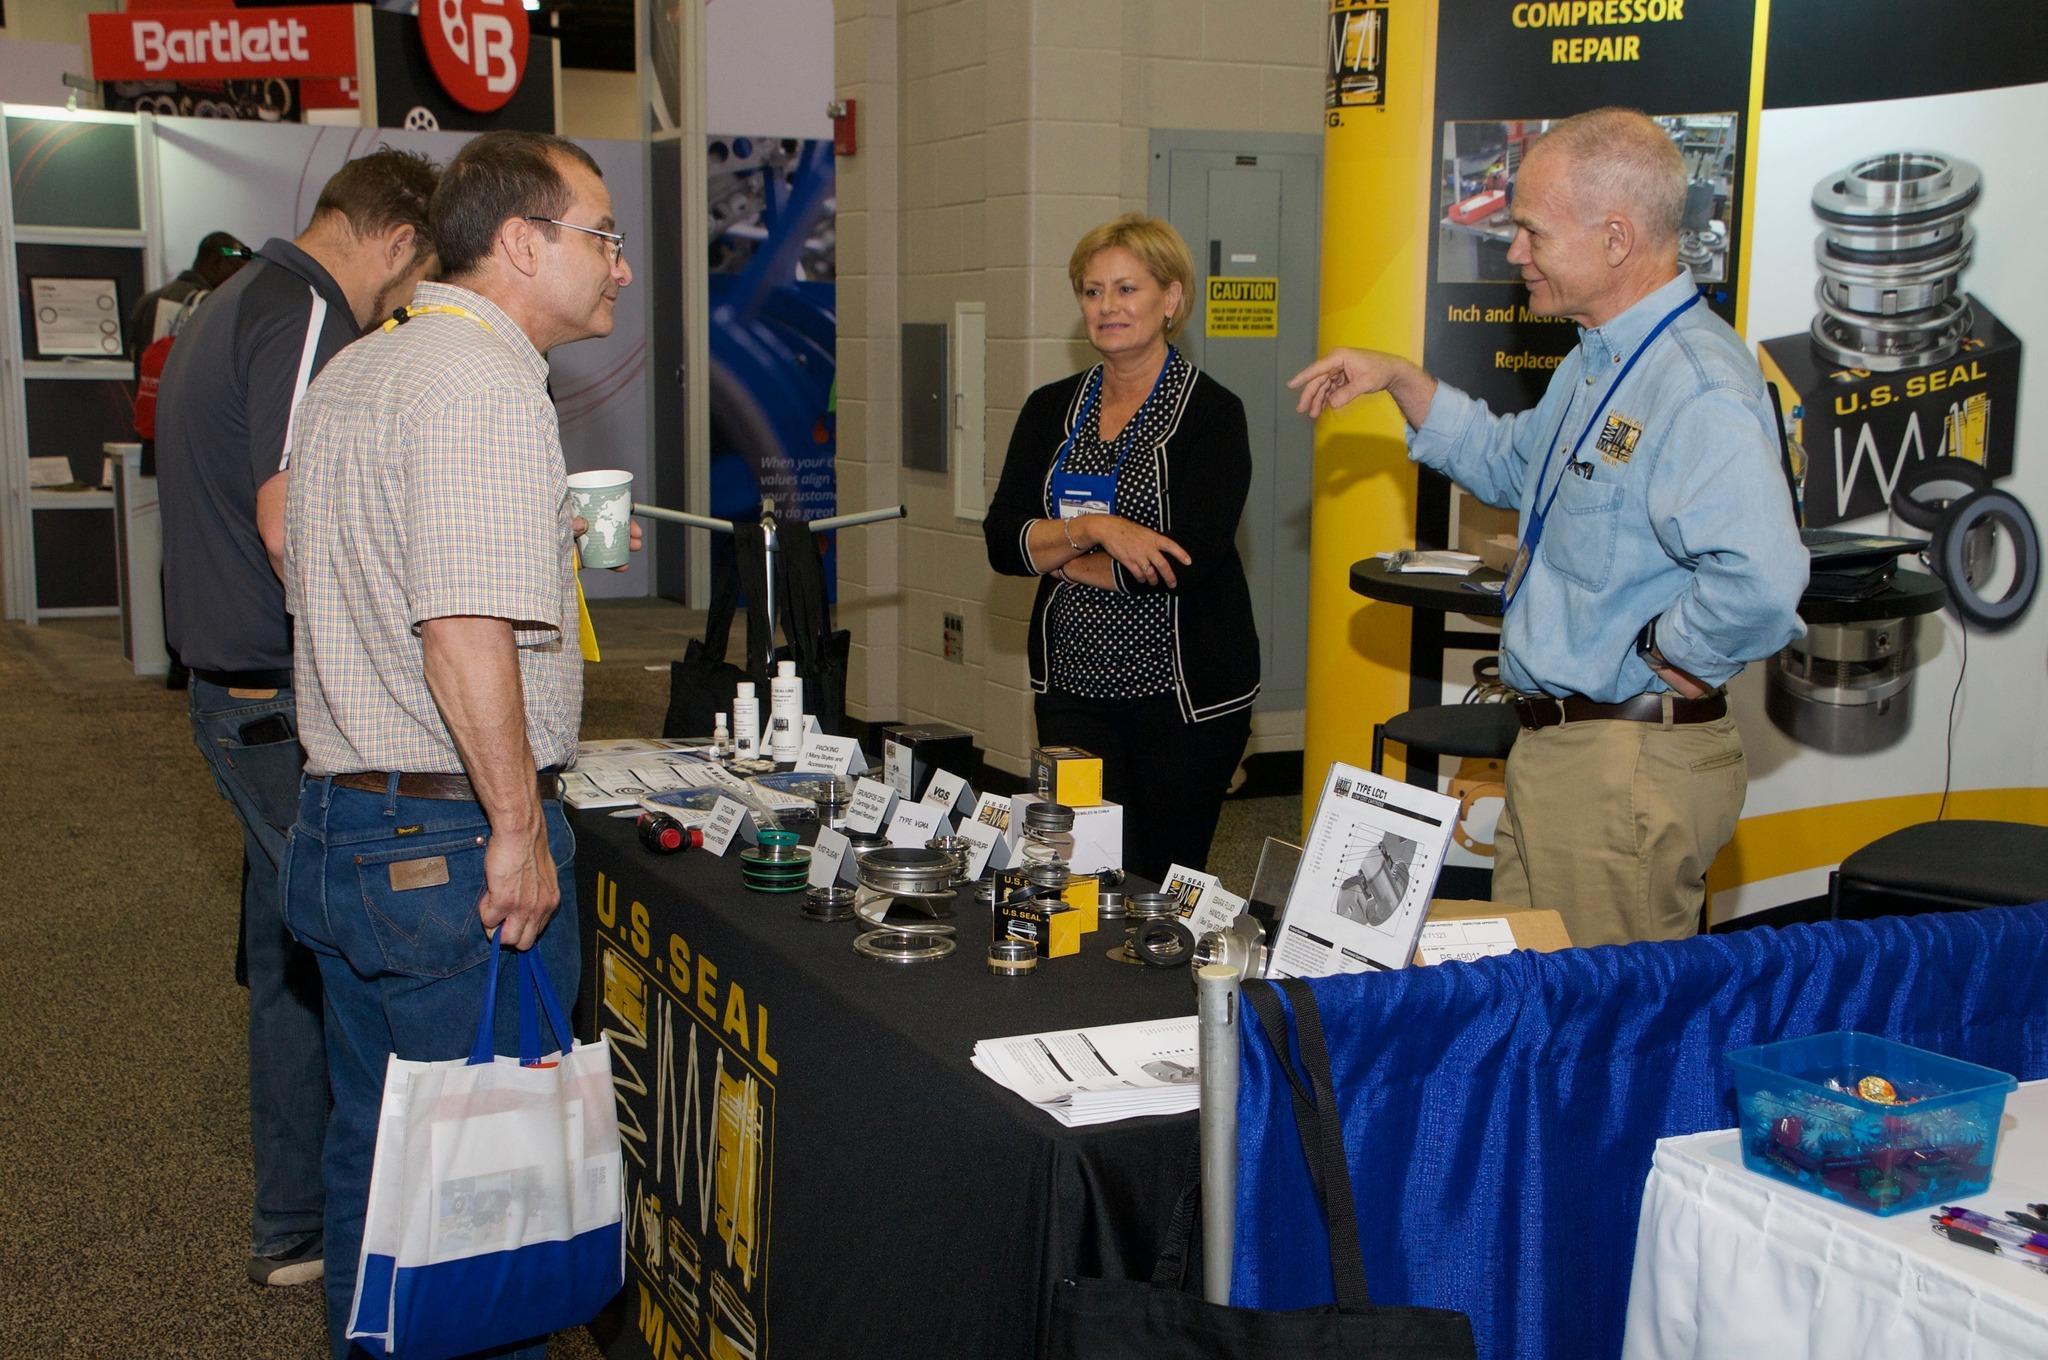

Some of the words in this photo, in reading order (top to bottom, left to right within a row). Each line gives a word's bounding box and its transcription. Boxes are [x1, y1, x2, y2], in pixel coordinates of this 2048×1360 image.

[1511, 0, 1685, 29] COMPRESSOR
[131, 17, 311, 72] Bartlett
[1551, 35, 1640, 64] REPAIR
[1212, 282, 1275, 300] CAUTION
[1448, 304, 1480, 323] Inch
[1484, 304, 1515, 323] and
[1495, 350, 1567, 373] Replacem
[1834, 383, 1901, 416] U.S.
[1905, 360, 1988, 399] SEAL
[761, 457, 795, 469] When
[797, 459, 825, 471] your
[761, 474, 799, 486] values
[801, 474, 831, 488] align
[791, 491, 836, 503] custom
[933, 785, 951, 801] VGS
[1356, 782, 1372, 795] TYPE
[898, 815, 913, 826] TYPE
[1173, 872, 1187, 884] U.S.
[1186, 877, 1206, 889] SEAL
[1002, 907, 1019, 918] U.S.
[1019, 911, 1041, 922] SEAL
[1440, 951, 1480, 963] PS-4901
[637, 1280, 694, 1360] MF
